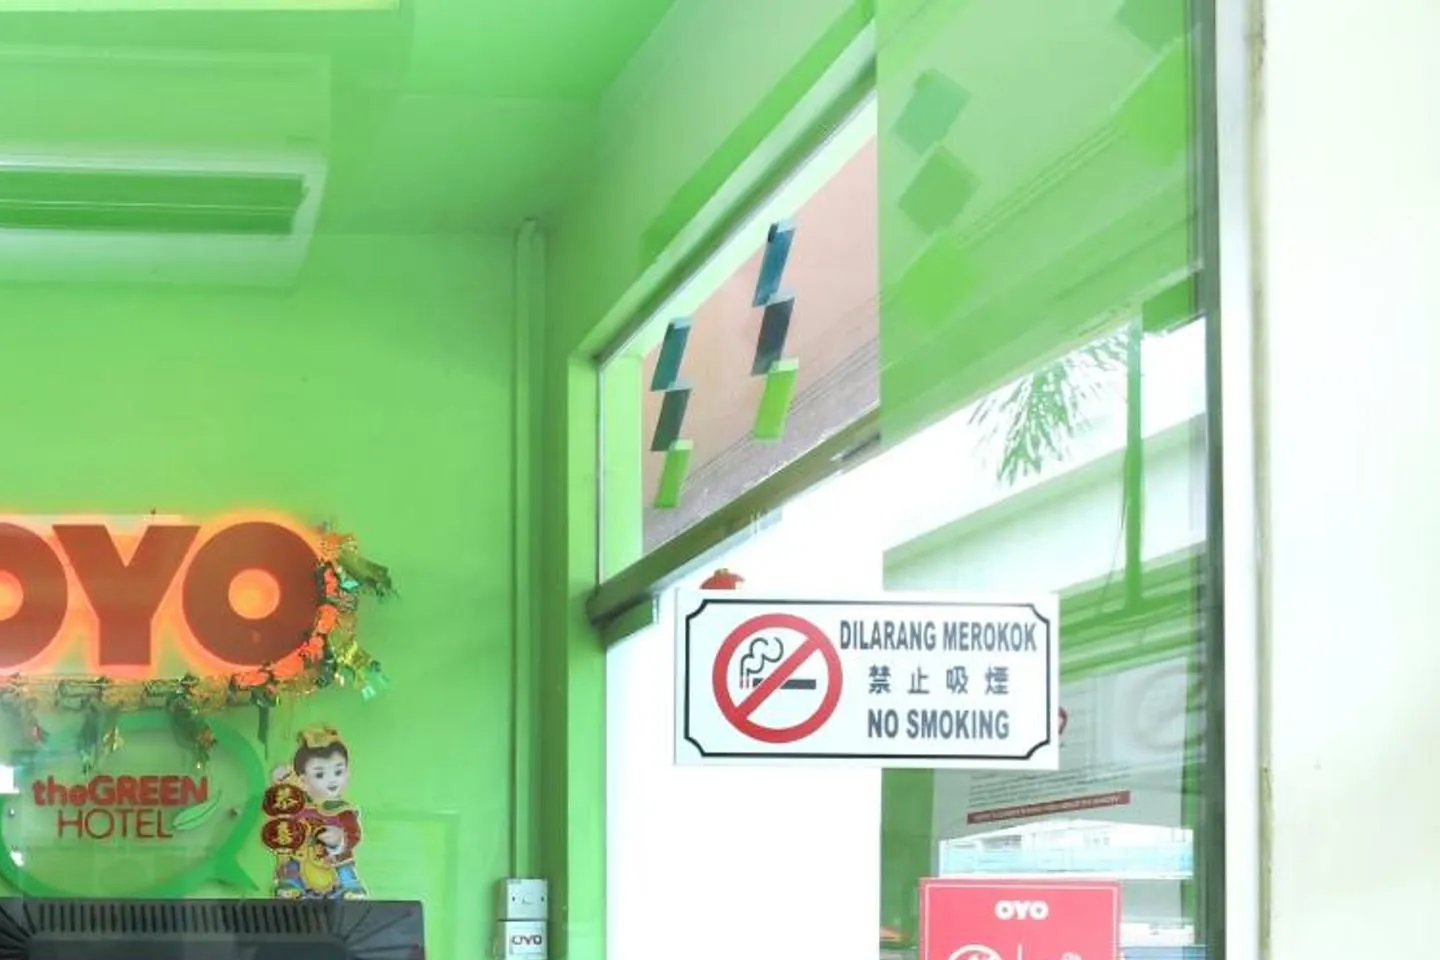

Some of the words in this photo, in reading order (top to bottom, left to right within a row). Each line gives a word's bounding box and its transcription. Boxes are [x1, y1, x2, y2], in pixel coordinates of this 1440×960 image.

[840, 620, 936, 652] DILARANG
[942, 621, 1037, 653] MEROKOK
[867, 709, 899, 739] NO
[906, 709, 1010, 740] SMOKING
[33, 775, 208, 806] theGREEN
[58, 808, 173, 839] HOTEL
[995, 901, 1049, 920] OYO
[512, 935, 542, 945] OYO
